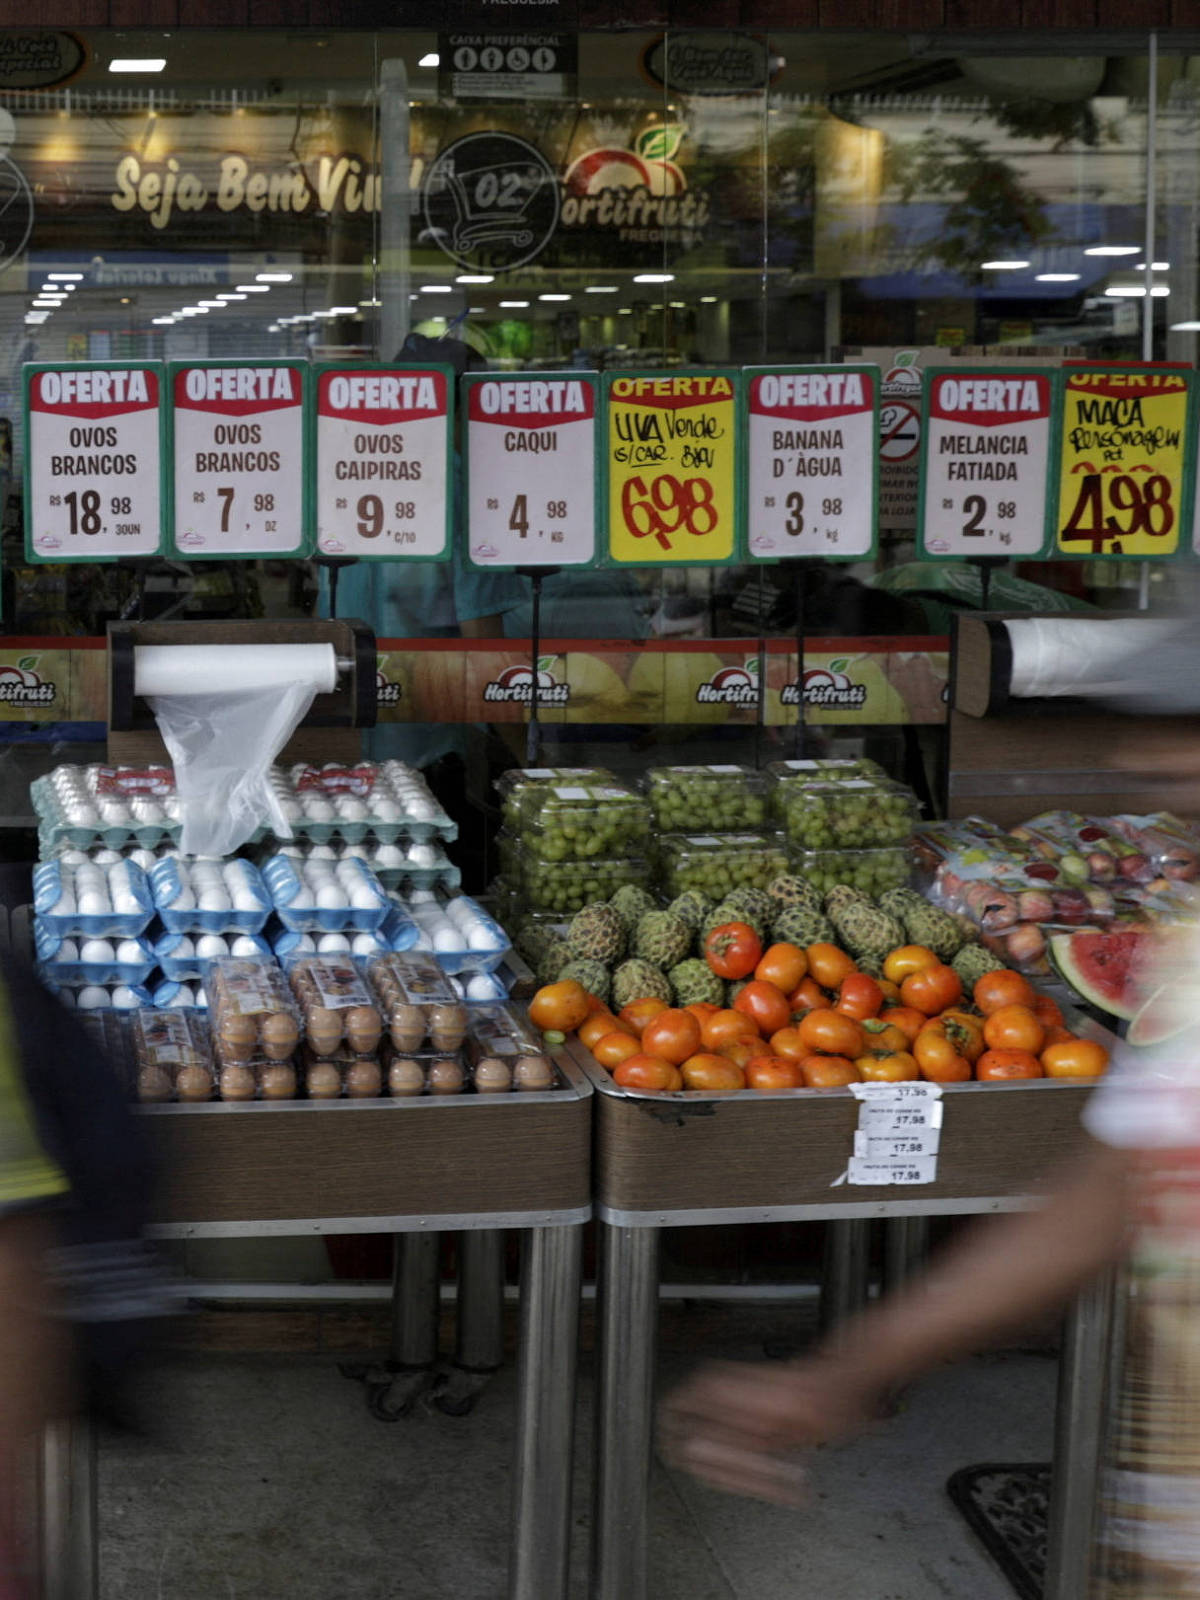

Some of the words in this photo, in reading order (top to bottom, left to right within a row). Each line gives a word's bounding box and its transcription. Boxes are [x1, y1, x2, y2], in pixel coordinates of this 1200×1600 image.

[111, 156, 207, 230] Seja
[217, 156, 310, 212] Bem
[475, 172, 521, 208] 02
[561, 185, 711, 226] ortifruti
[40, 370, 148, 404] OFERTA
[186, 368, 293, 401] OFERTA
[328, 376, 438, 410] OFERTA
[612, 376, 732, 397] OFERTA
[759, 374, 864, 408] OFERTA
[940, 380, 1040, 412] OFERTA
[480, 381, 585, 414] OFERTA
[70, 427, 118, 448] OVOS
[214, 424, 262, 445] OVOS
[615, 412, 665, 443] UVA
[354, 434, 404, 454] OVOS
[504, 431, 558, 454] CAQUI
[773, 430, 844, 450] BANANA
[940, 435, 1028, 456] MELANCIA
[52, 454, 136, 476] BRANCOS
[196, 451, 280, 473] BRANCOS
[335, 460, 422, 480] CAIPIRAS
[948, 462, 1018, 482] FATIADA
